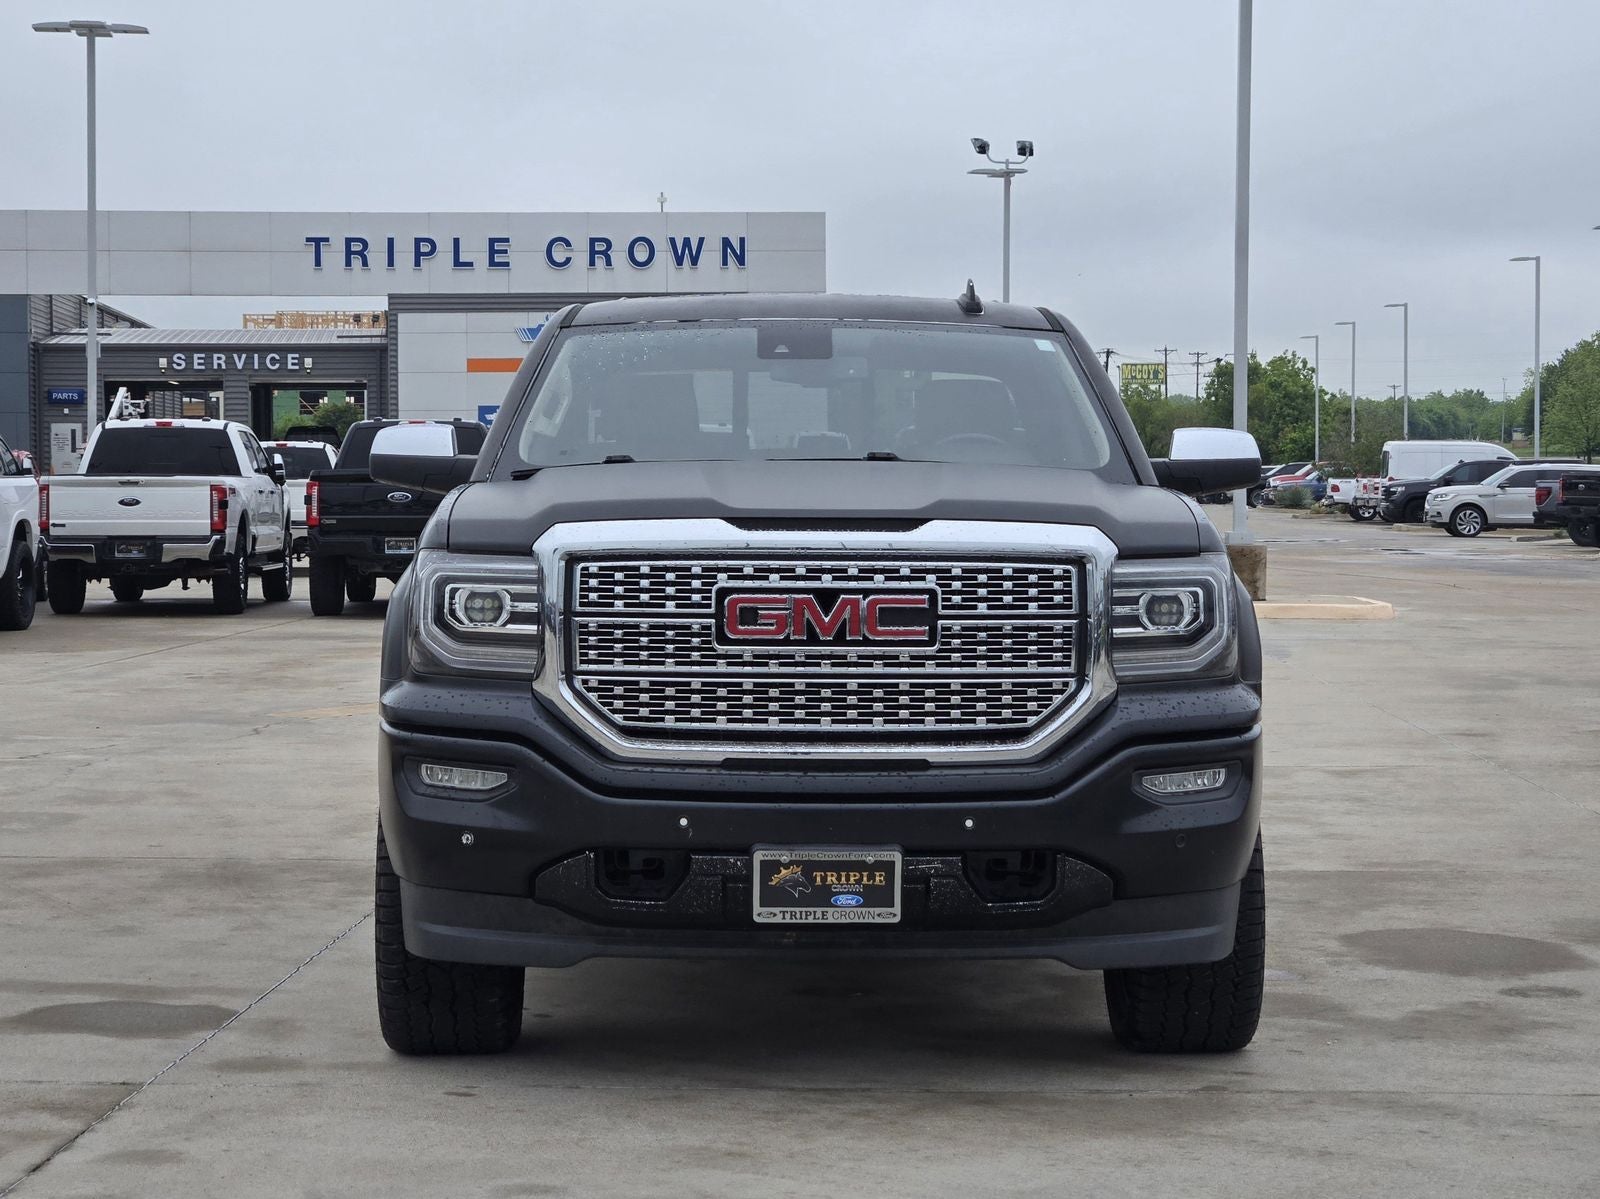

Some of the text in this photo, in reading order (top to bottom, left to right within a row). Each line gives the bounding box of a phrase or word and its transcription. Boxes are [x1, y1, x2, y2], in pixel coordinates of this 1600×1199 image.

[304, 236, 748, 270] TRIPLE CROWN
[172, 353, 300, 370] SERVICE
[52, 392, 79, 400] PARTS
[723, 594, 930, 640] GMC
[812, 871, 886, 886] TRIPLE
[831, 884, 863, 892] CROWN
[779, 910, 829, 920] TRIPLE
[832, 910, 876, 920] CROWN
